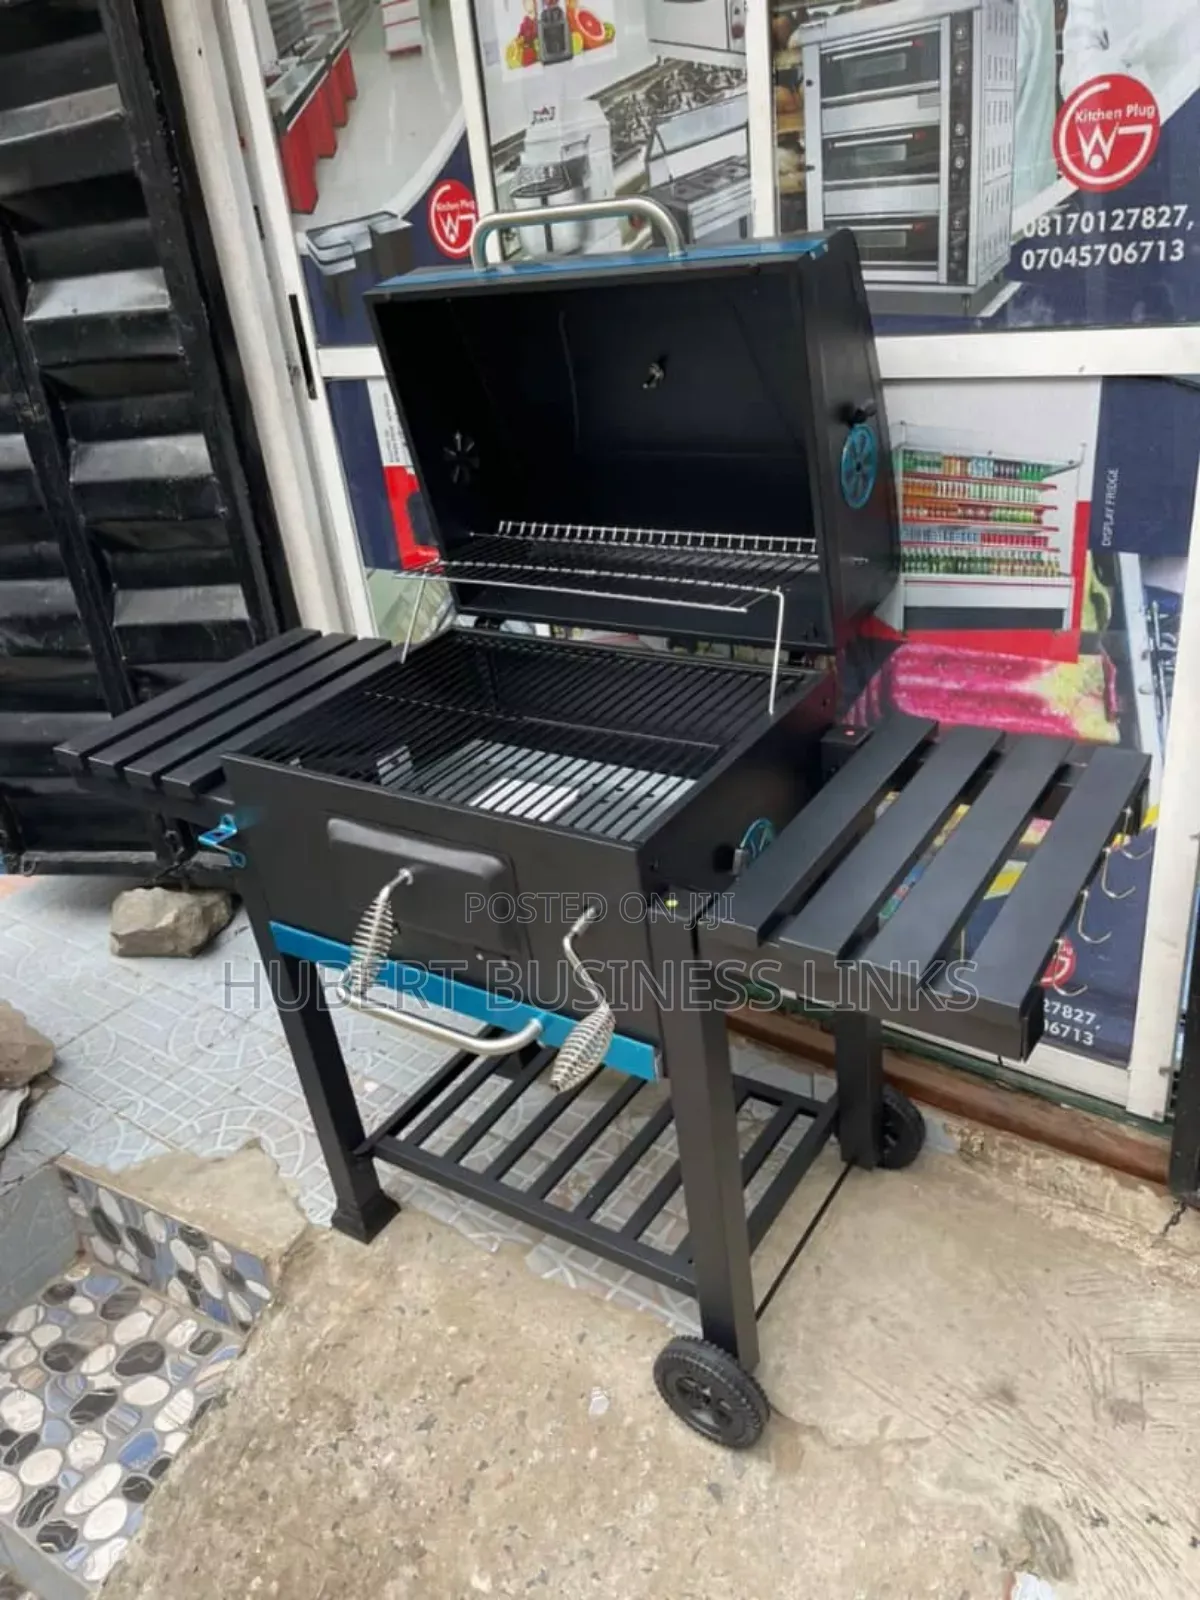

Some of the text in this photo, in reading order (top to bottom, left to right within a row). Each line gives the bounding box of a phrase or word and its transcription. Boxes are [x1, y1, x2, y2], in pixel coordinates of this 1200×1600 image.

[1075, 102, 1156, 122] Kitchen Plug
[1023, 204, 1195, 238] 08170127827,
[1021, 239, 1185, 271] 07045706713
